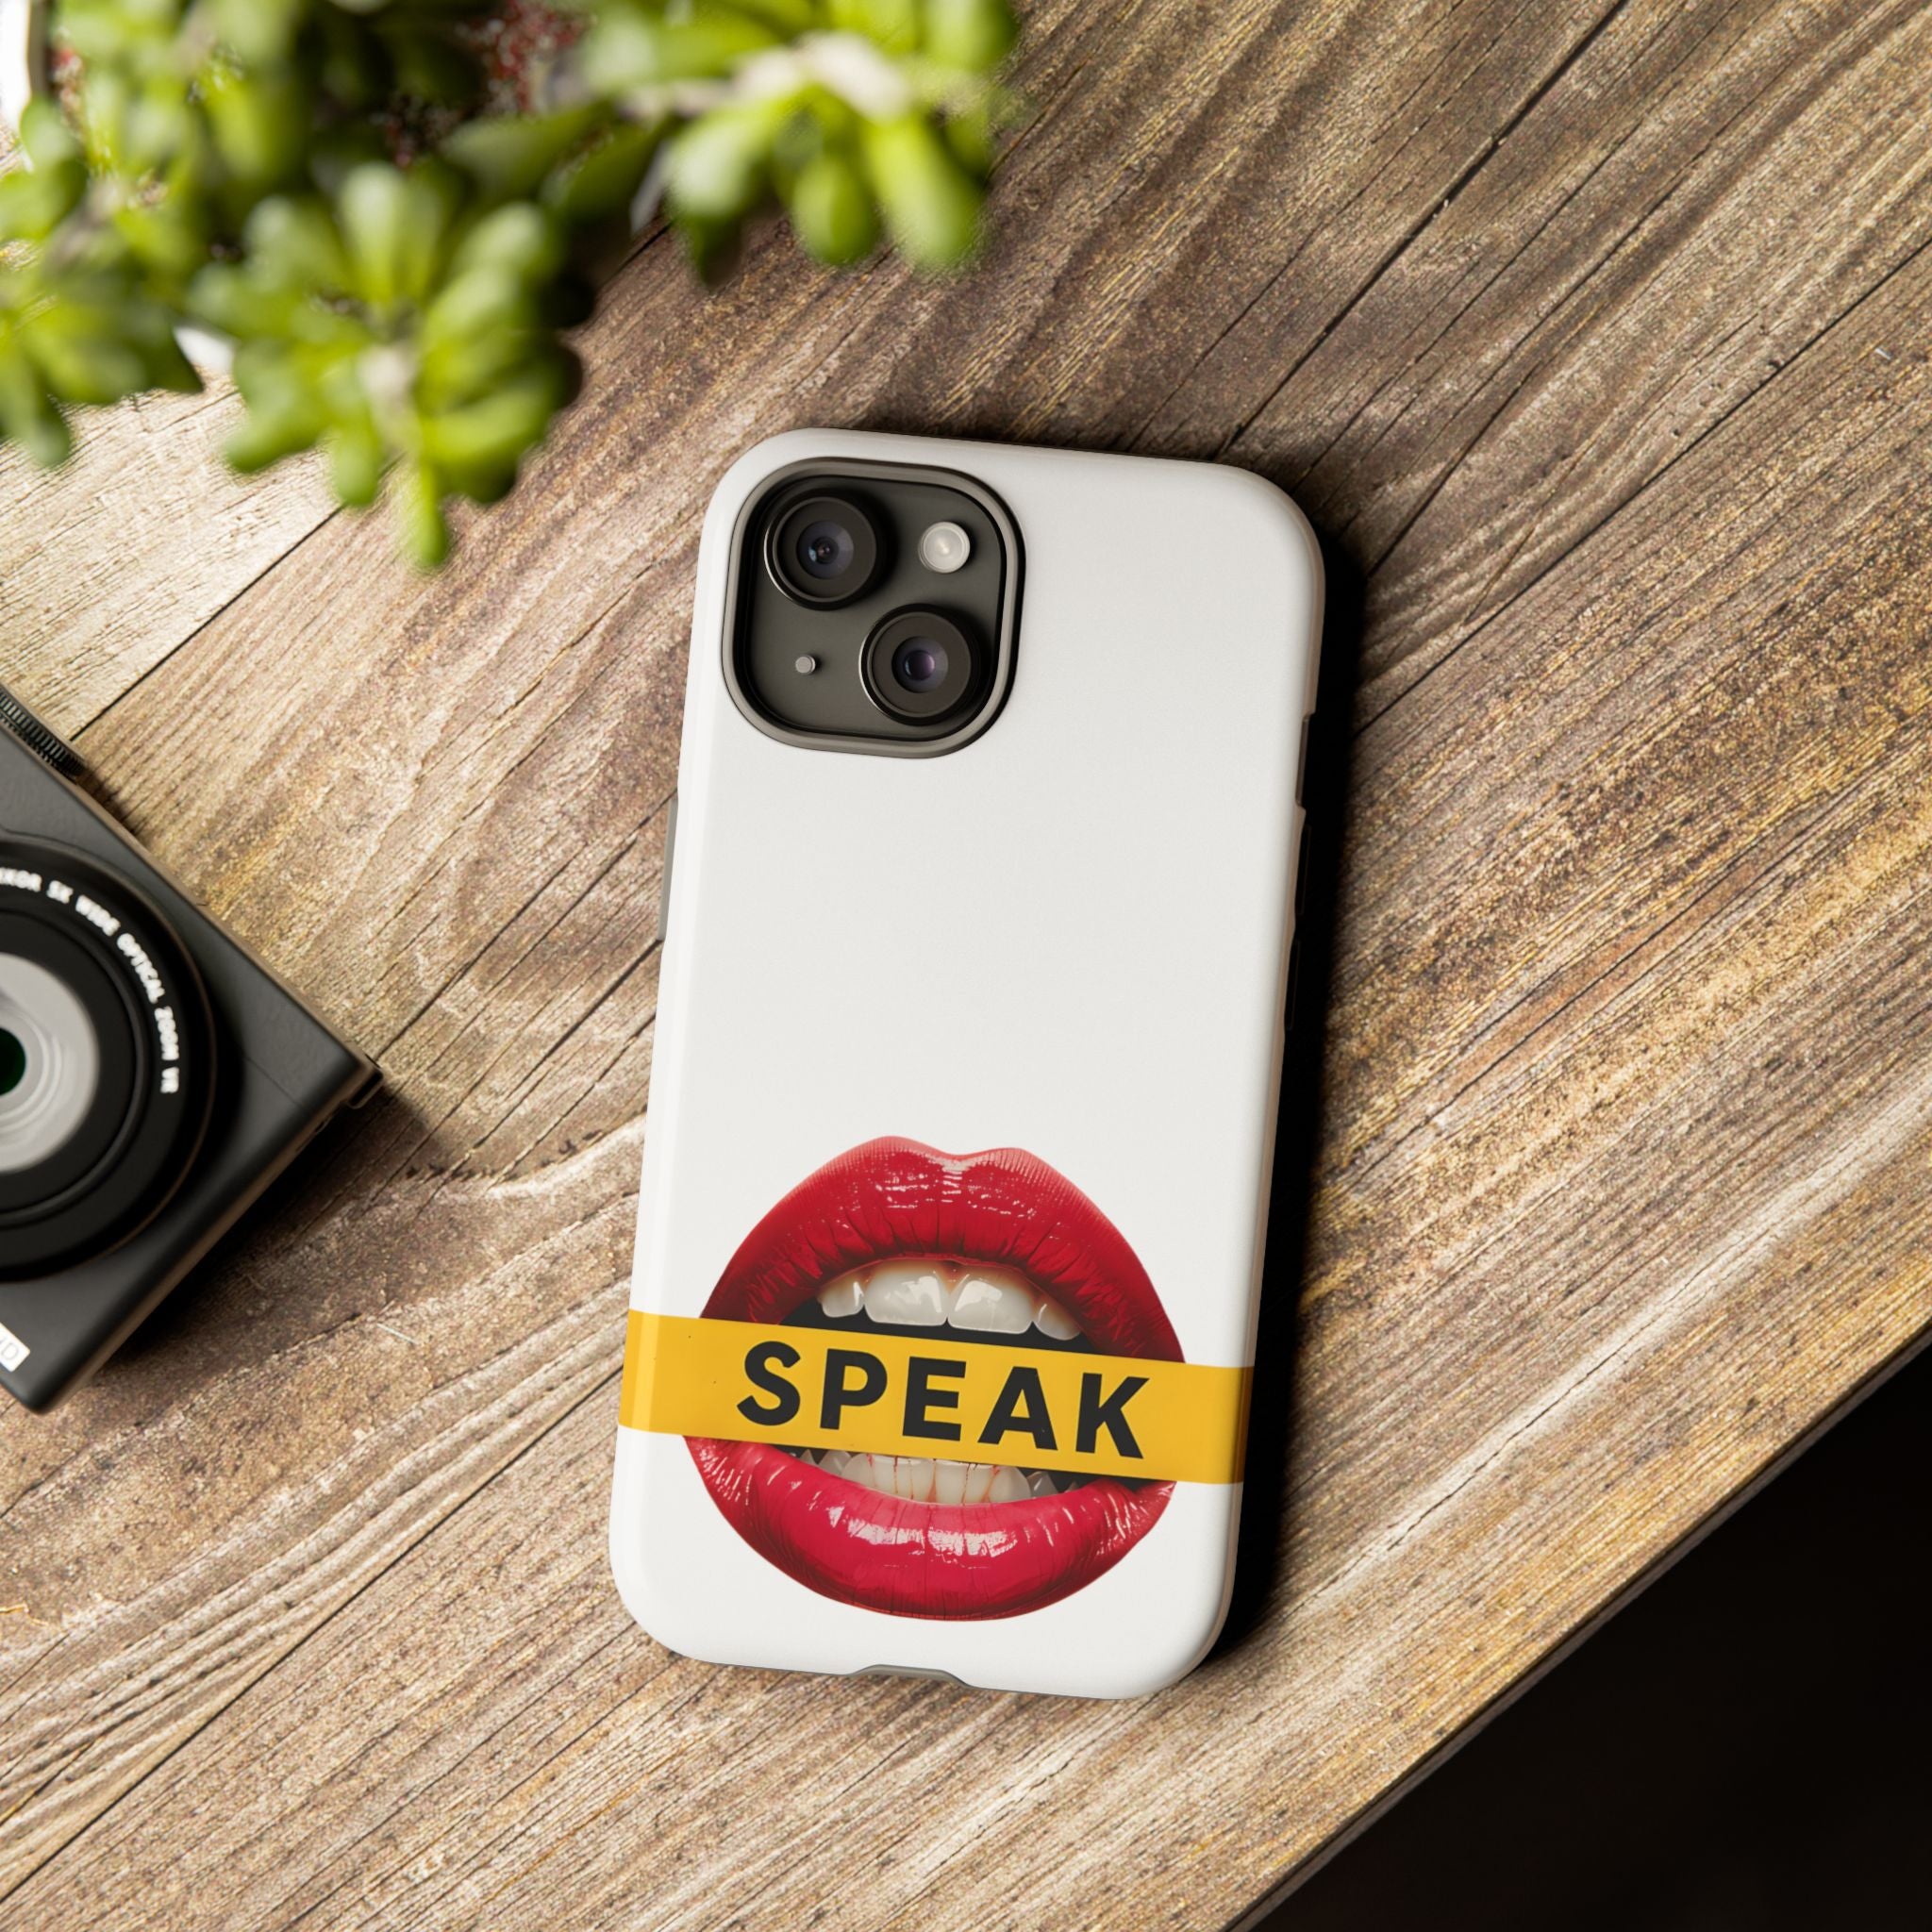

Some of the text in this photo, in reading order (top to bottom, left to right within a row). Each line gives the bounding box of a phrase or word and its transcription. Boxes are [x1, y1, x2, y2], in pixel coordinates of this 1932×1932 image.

[75, 894, 121, 936] WIDE
[116, 931, 165, 1004] OPTICAL
[154, 1006, 179, 1061] ZOOM
[737, 1341, 1150, 1459] SPEAK
